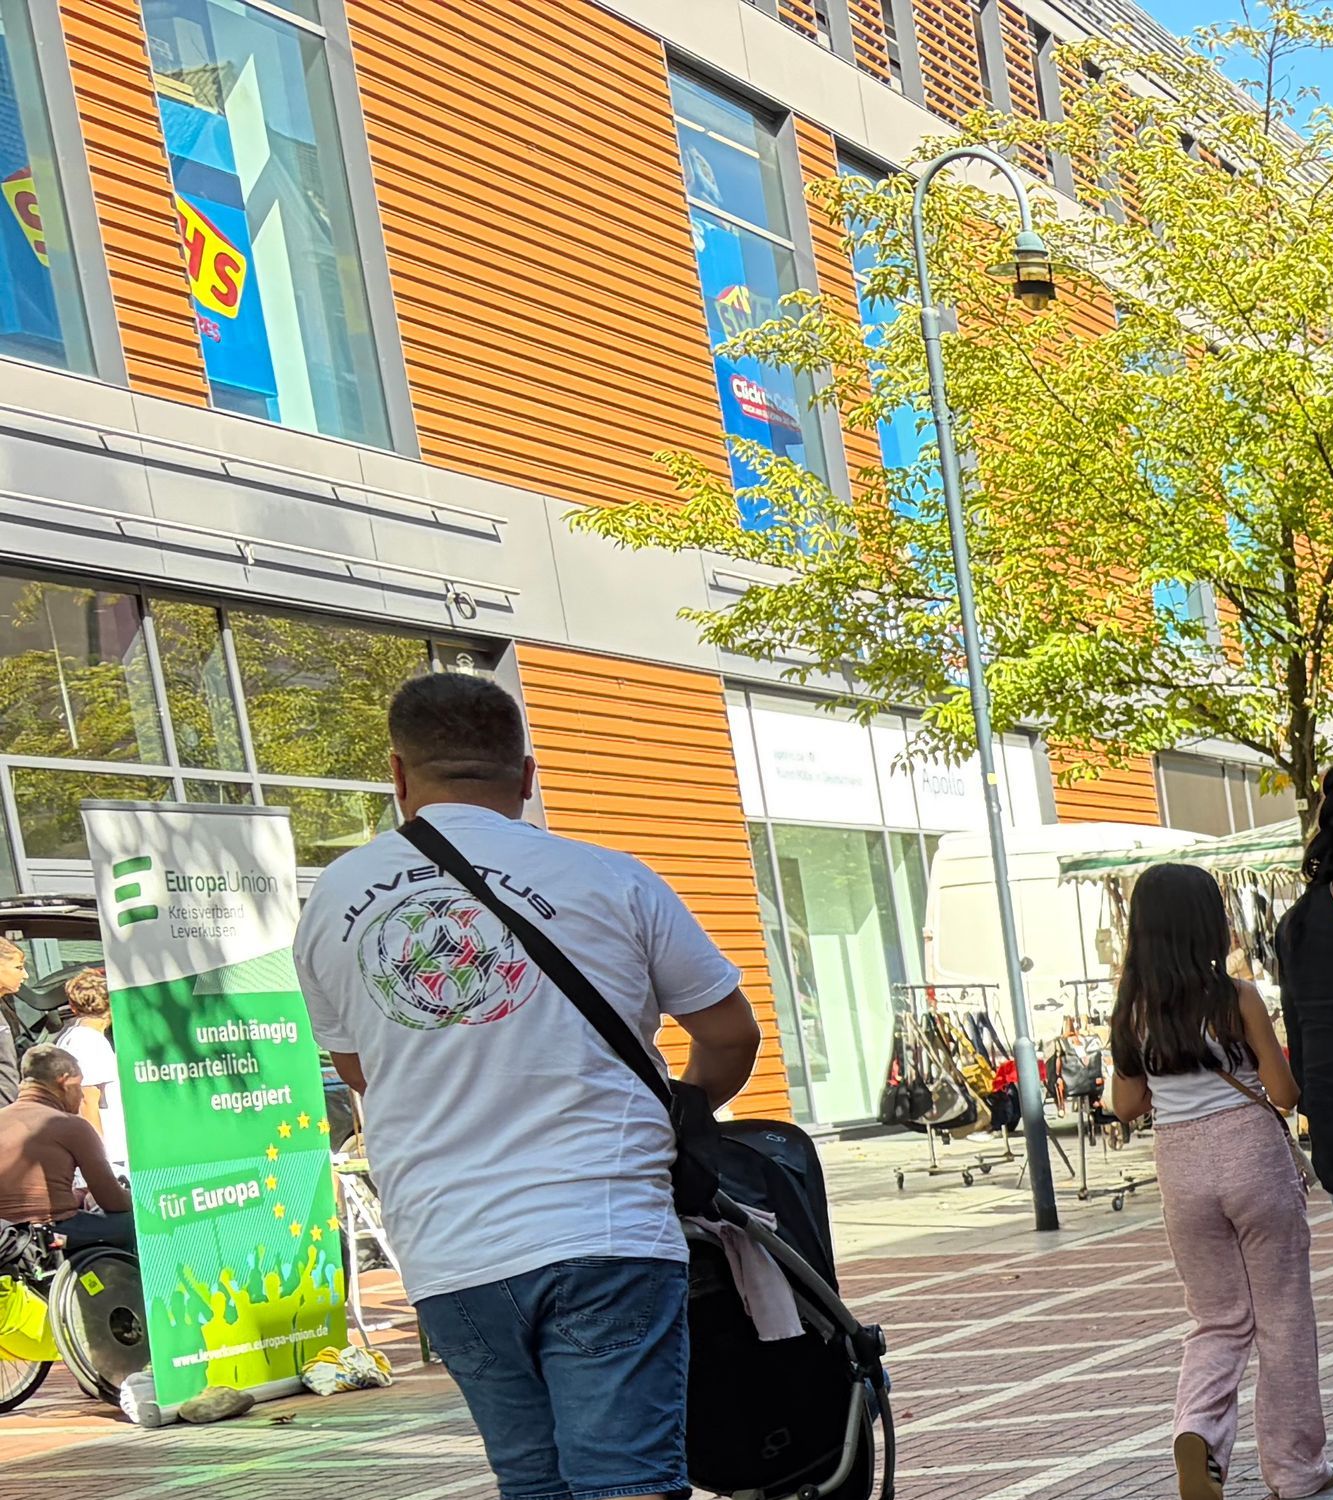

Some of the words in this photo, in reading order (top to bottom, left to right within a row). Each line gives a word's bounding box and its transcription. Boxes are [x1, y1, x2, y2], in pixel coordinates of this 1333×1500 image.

[923, 769, 965, 797] Apollo
[168, 904, 244, 920] Kreisverband
[171, 922, 237, 938] Leverkusen
[196, 1018, 298, 1044] unabhängig
[135, 1054, 259, 1085] überparteilich
[211, 1084, 292, 1113] engagiert
[158, 1193, 189, 1220] für
[192, 1180, 260, 1212] Europa
